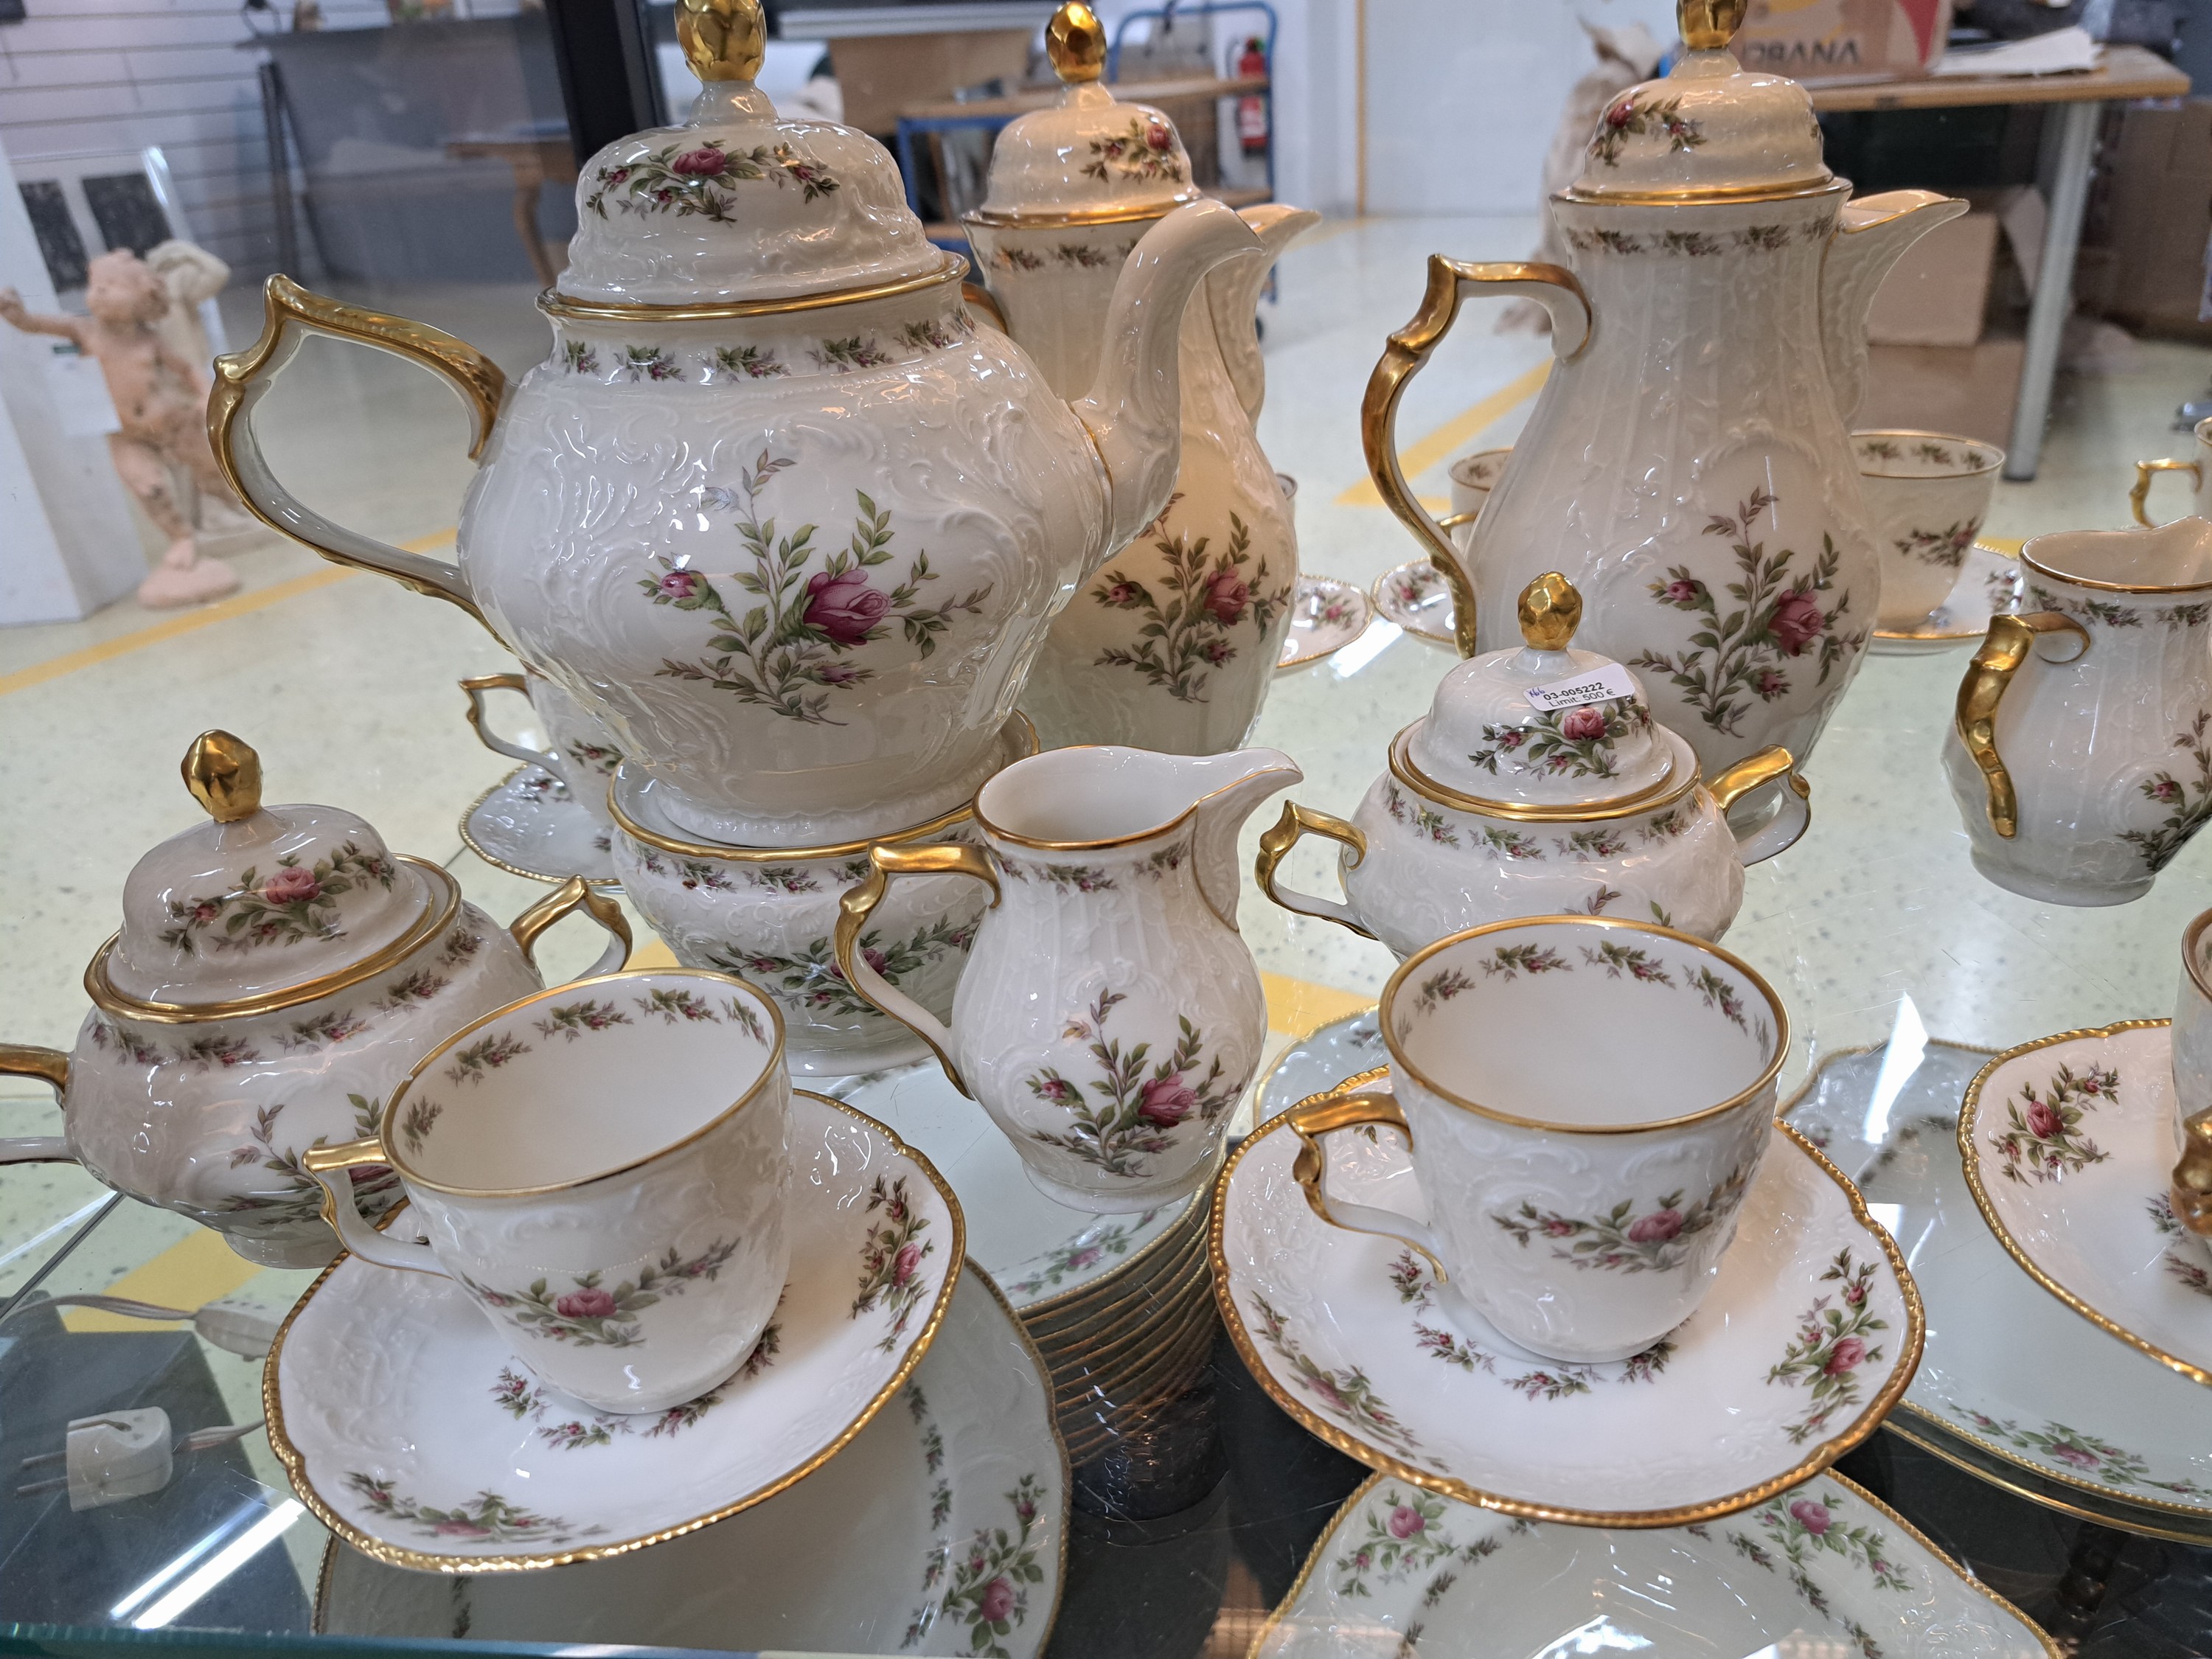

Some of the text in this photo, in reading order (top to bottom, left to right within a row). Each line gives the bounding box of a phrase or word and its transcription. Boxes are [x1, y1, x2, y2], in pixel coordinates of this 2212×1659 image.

[1543, 682, 1605, 700] 03-005222
[1548, 688, 1616, 707] Limit: 500 €
